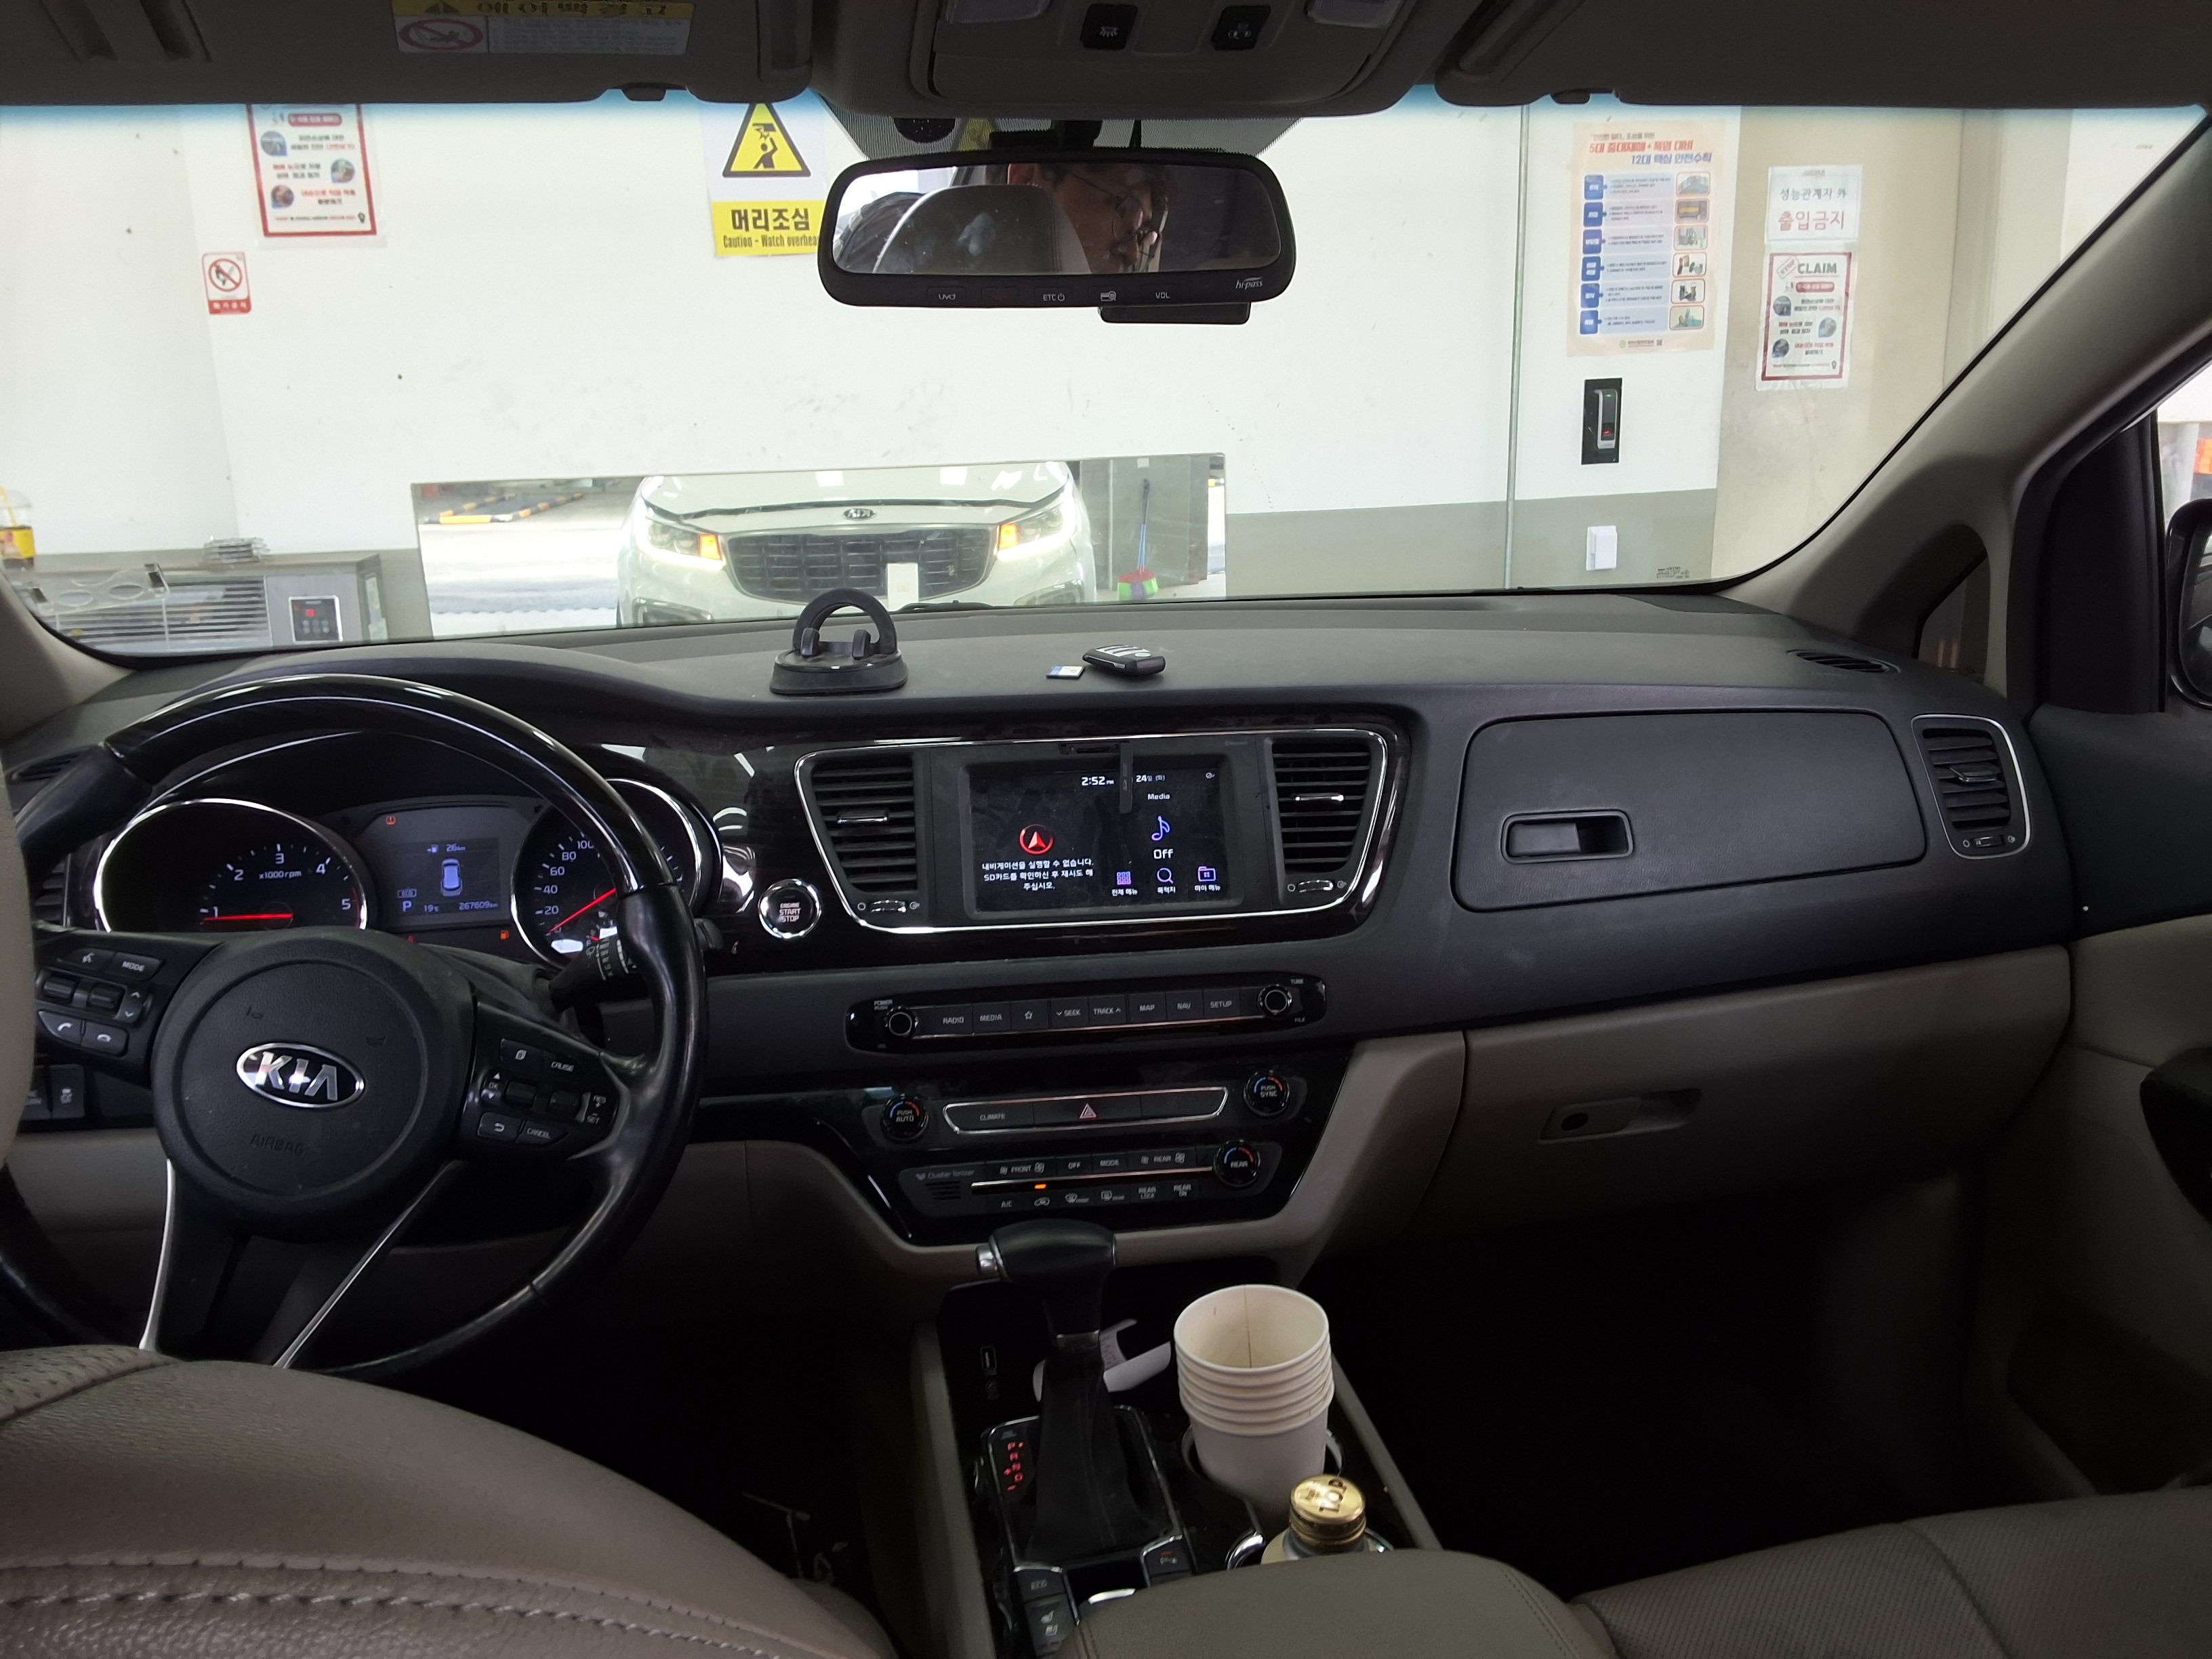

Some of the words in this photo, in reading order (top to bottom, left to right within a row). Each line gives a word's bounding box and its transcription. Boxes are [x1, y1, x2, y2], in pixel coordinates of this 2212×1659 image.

[731, 208, 810, 232] 머리조심
[1778, 210, 1845, 231] 출입금지
[723, 235, 753, 249] Caution
[761, 234, 785, 247] Watch
[1797, 262, 1837, 274] CLAIM
[1082, 776, 1106, 786] 2:52
[1147, 792, 1170, 800] Media
[275, 853, 285, 864] 3
[562, 851, 577, 861] 80
[1153, 848, 1174, 859] Off
[1052, 859, 1061, 867] 수
[1062, 858, 1094, 868] 없습니다.
[316, 863, 327, 875] 4
[550, 866, 565, 876] 60
[234, 869, 244, 881] 2
[983, 872, 1018, 882] SD카드를
[1019, 871, 1050, 881] 확인하신
[543, 884, 558, 895] 40
[342, 898, 351, 910] 5
[403, 901, 412, 912] P
[544, 905, 559, 915] 20
[122, 961, 145, 972] MODE
[1177, 1002, 1191, 1010] NAV
[979, 1014, 1002, 1022] MEDIA
[255, 1051, 338, 1101] KIA
[1001, 1200, 1012, 1208] A/C
